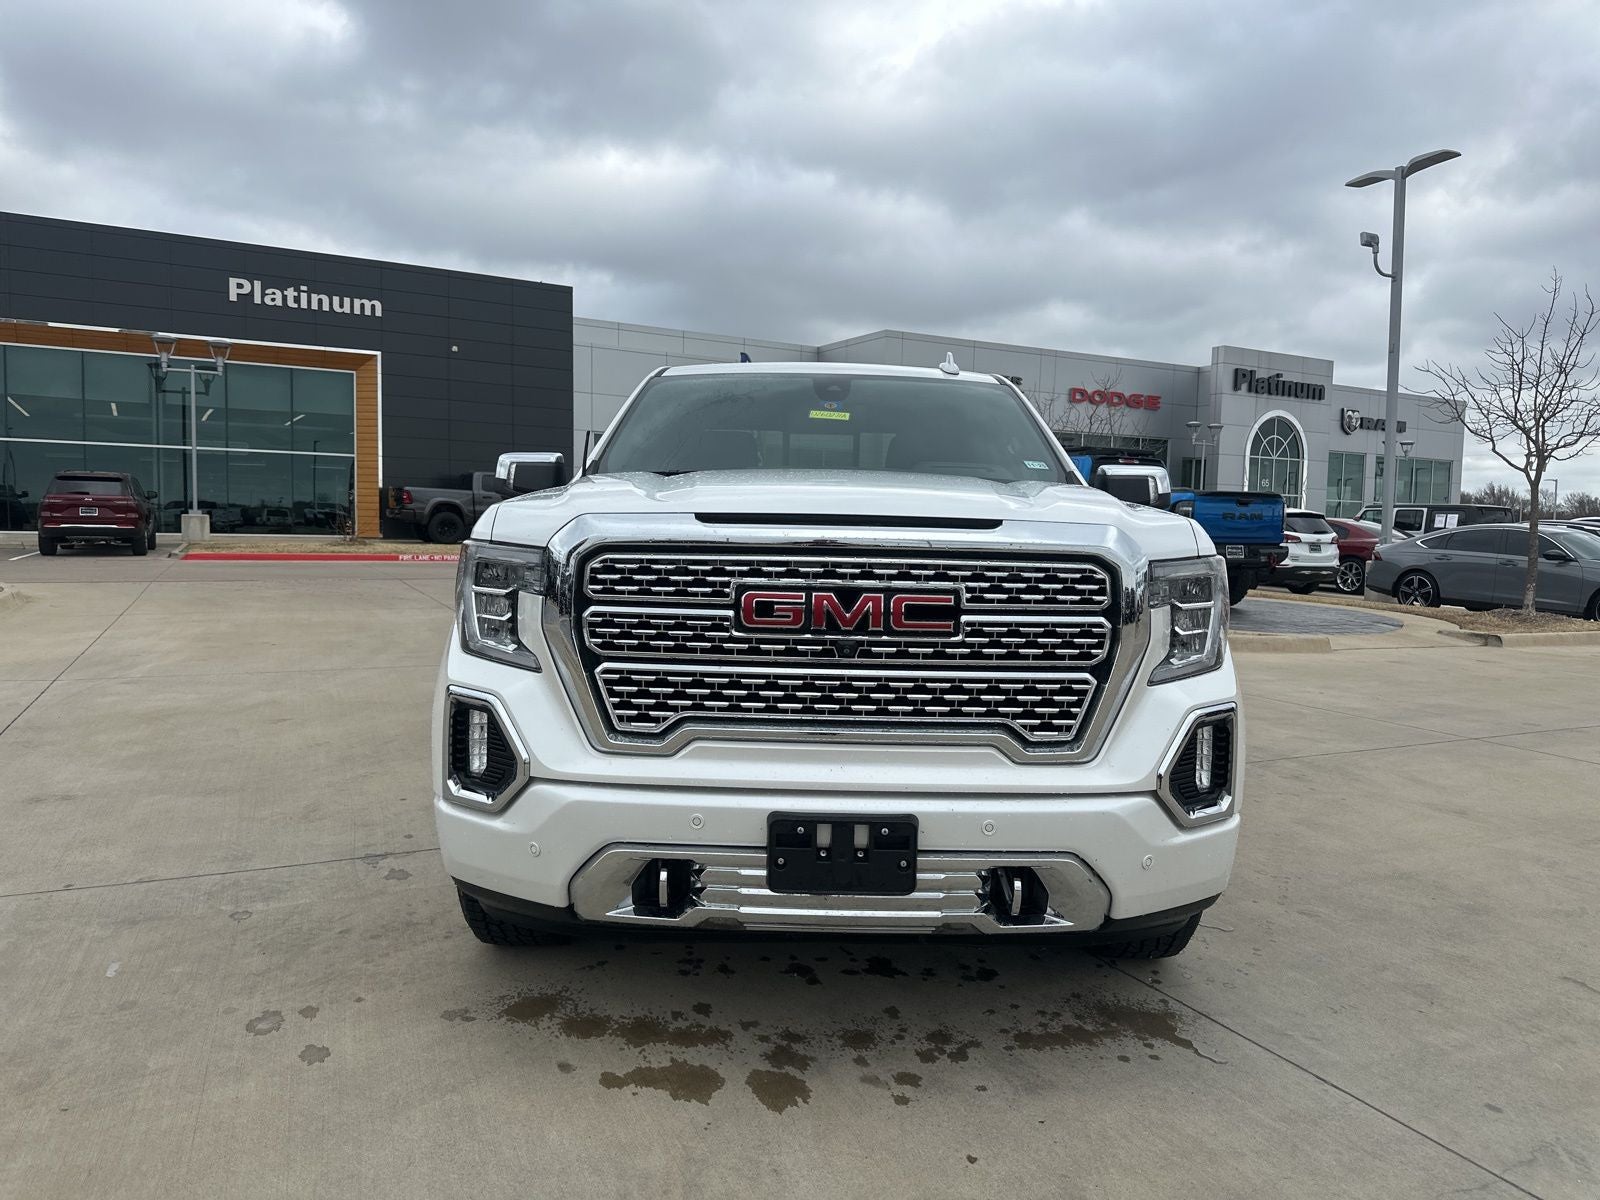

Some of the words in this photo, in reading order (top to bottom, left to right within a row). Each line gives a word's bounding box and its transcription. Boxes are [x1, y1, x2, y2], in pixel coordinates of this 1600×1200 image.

[228, 277, 383, 317] Platinum
[1070, 387, 1162, 411] DODGE
[1234, 368, 1326, 400] Platinum
[1222, 512, 1264, 520] RAM
[741, 591, 955, 632] GMC
